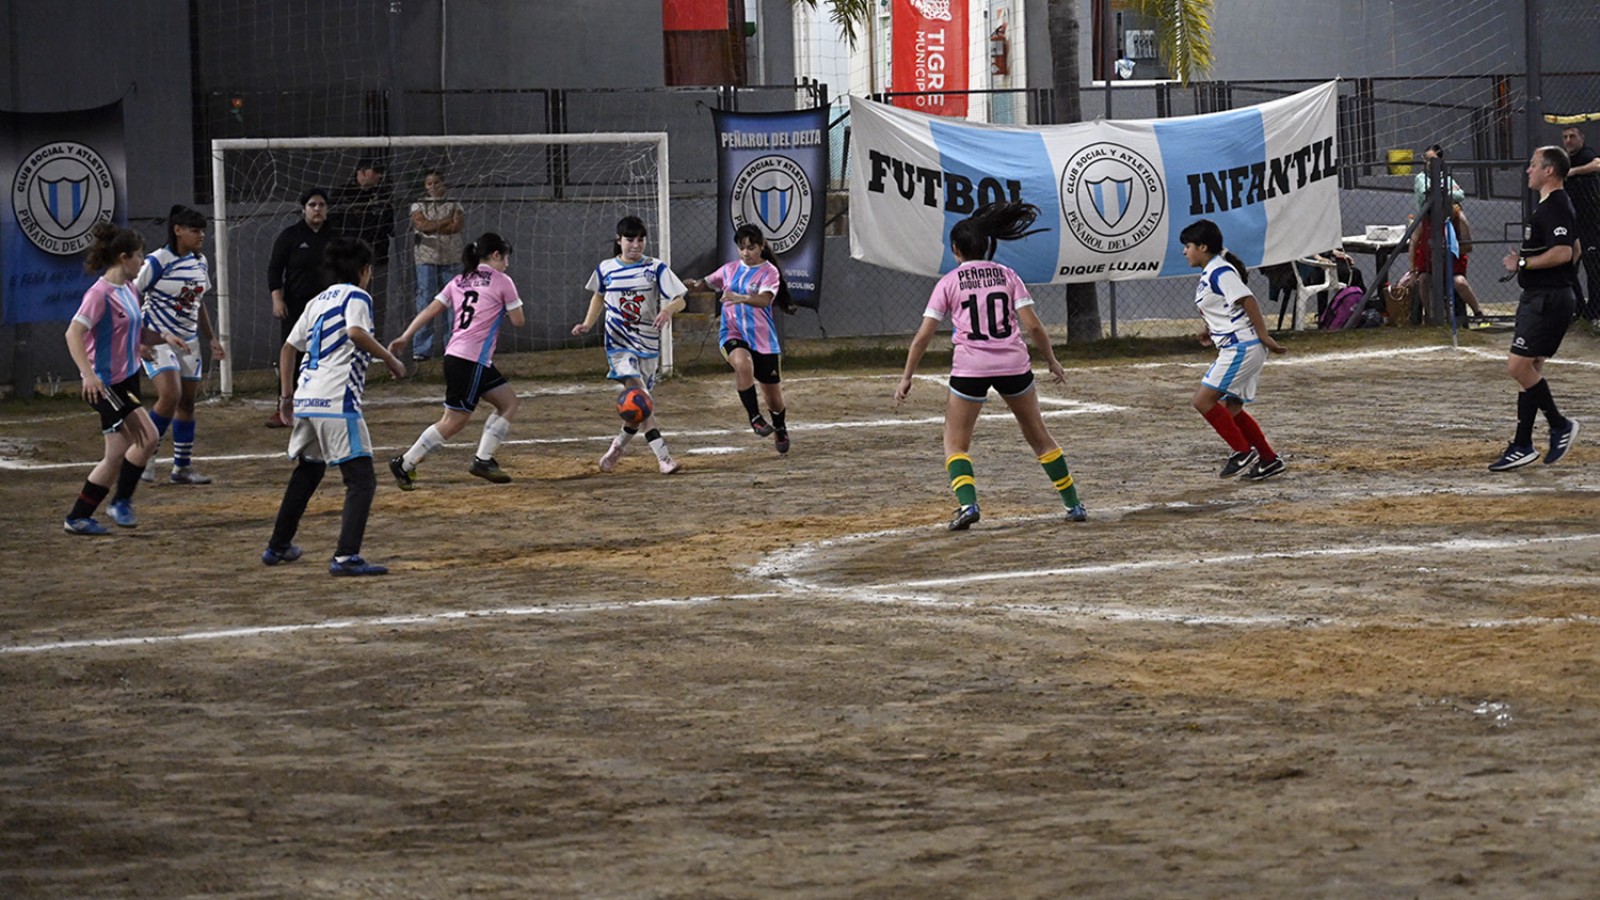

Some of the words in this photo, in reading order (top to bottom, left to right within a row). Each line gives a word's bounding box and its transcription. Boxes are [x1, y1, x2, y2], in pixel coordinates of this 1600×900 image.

[915, 31, 926, 107] MUNICIPO
[927, 28, 945, 106] TIGRE
[721, 130, 768, 148] PEÑAROL
[771, 131, 790, 147] DEL
[793, 129, 821, 145] DELTA
[17, 165, 32, 192] CLUB
[31, 146, 64, 167] SOCIAL
[67, 145, 74, 154] Y
[734, 176, 747, 201] CLUB
[746, 160, 774, 178] SOCIAL
[783, 162, 809, 197] ATLETICO
[1066, 167, 1079, 194] CLUB
[1076, 149, 1107, 168] SOCIAL
[1119, 152, 1157, 193] ATLETICO
[1186, 136, 1339, 216] INFANTIL
[18, 208, 59, 252] PEÑAROL
[62, 240, 85, 253] DEL
[84, 208, 112, 243] DTA
[772, 241, 790, 252] DEL
[789, 213, 809, 241] DELTA
[1067, 210, 1104, 250] PEÑAROL
[1107, 241, 1130, 250] DEL
[1132, 211, 1159, 242] DELTA
[957, 266, 1005, 281] PEÑAROL
[959, 280, 982, 291] DIQUE
[1059, 263, 1106, 275] DIQUE
[1108, 261, 1160, 272] LUJAN
[459, 290, 479, 330] 6
[961, 292, 1012, 340] 10
